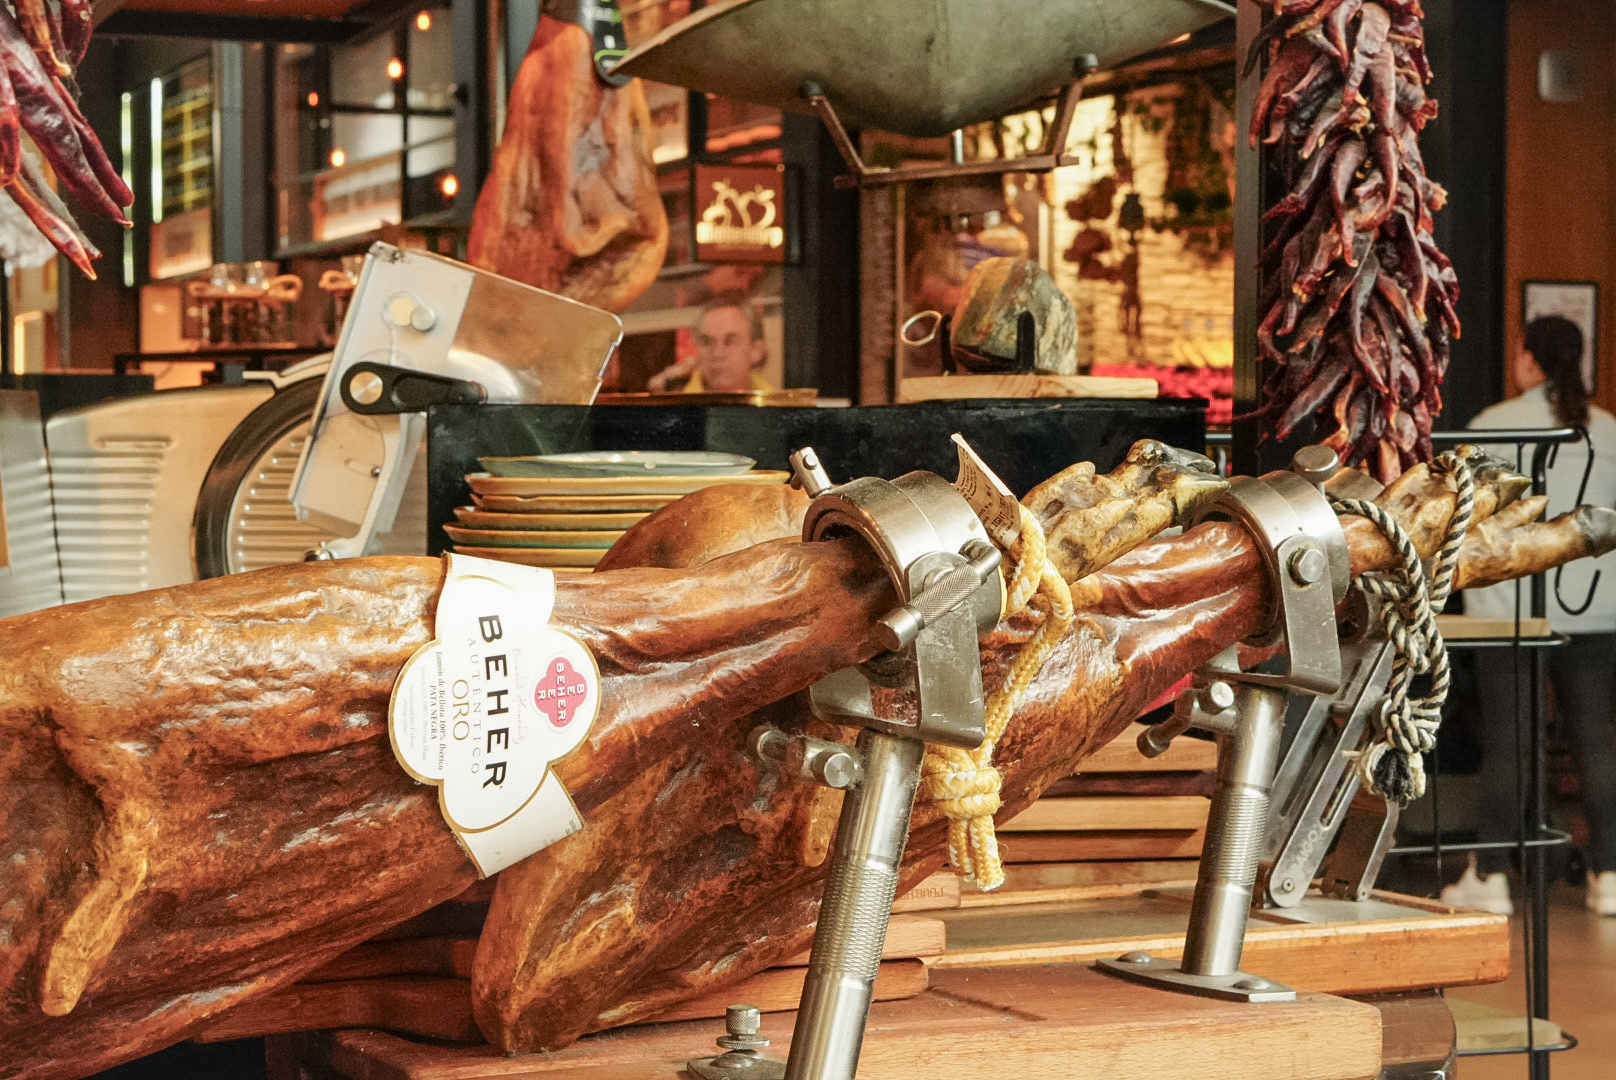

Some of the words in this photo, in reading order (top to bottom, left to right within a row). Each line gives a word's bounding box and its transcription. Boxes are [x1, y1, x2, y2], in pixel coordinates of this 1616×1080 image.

[438, 679, 446, 687] de
[439, 690, 447, 717] Bellota
[479, 615, 509, 788] BEHER
[538, 684, 584, 700] BEHER
[556, 663, 566, 720] BEHER
[452, 679, 470, 741] ORO
[468, 638, 482, 774] AUTÉNTICO
[438, 744, 447, 771] Ibérico
